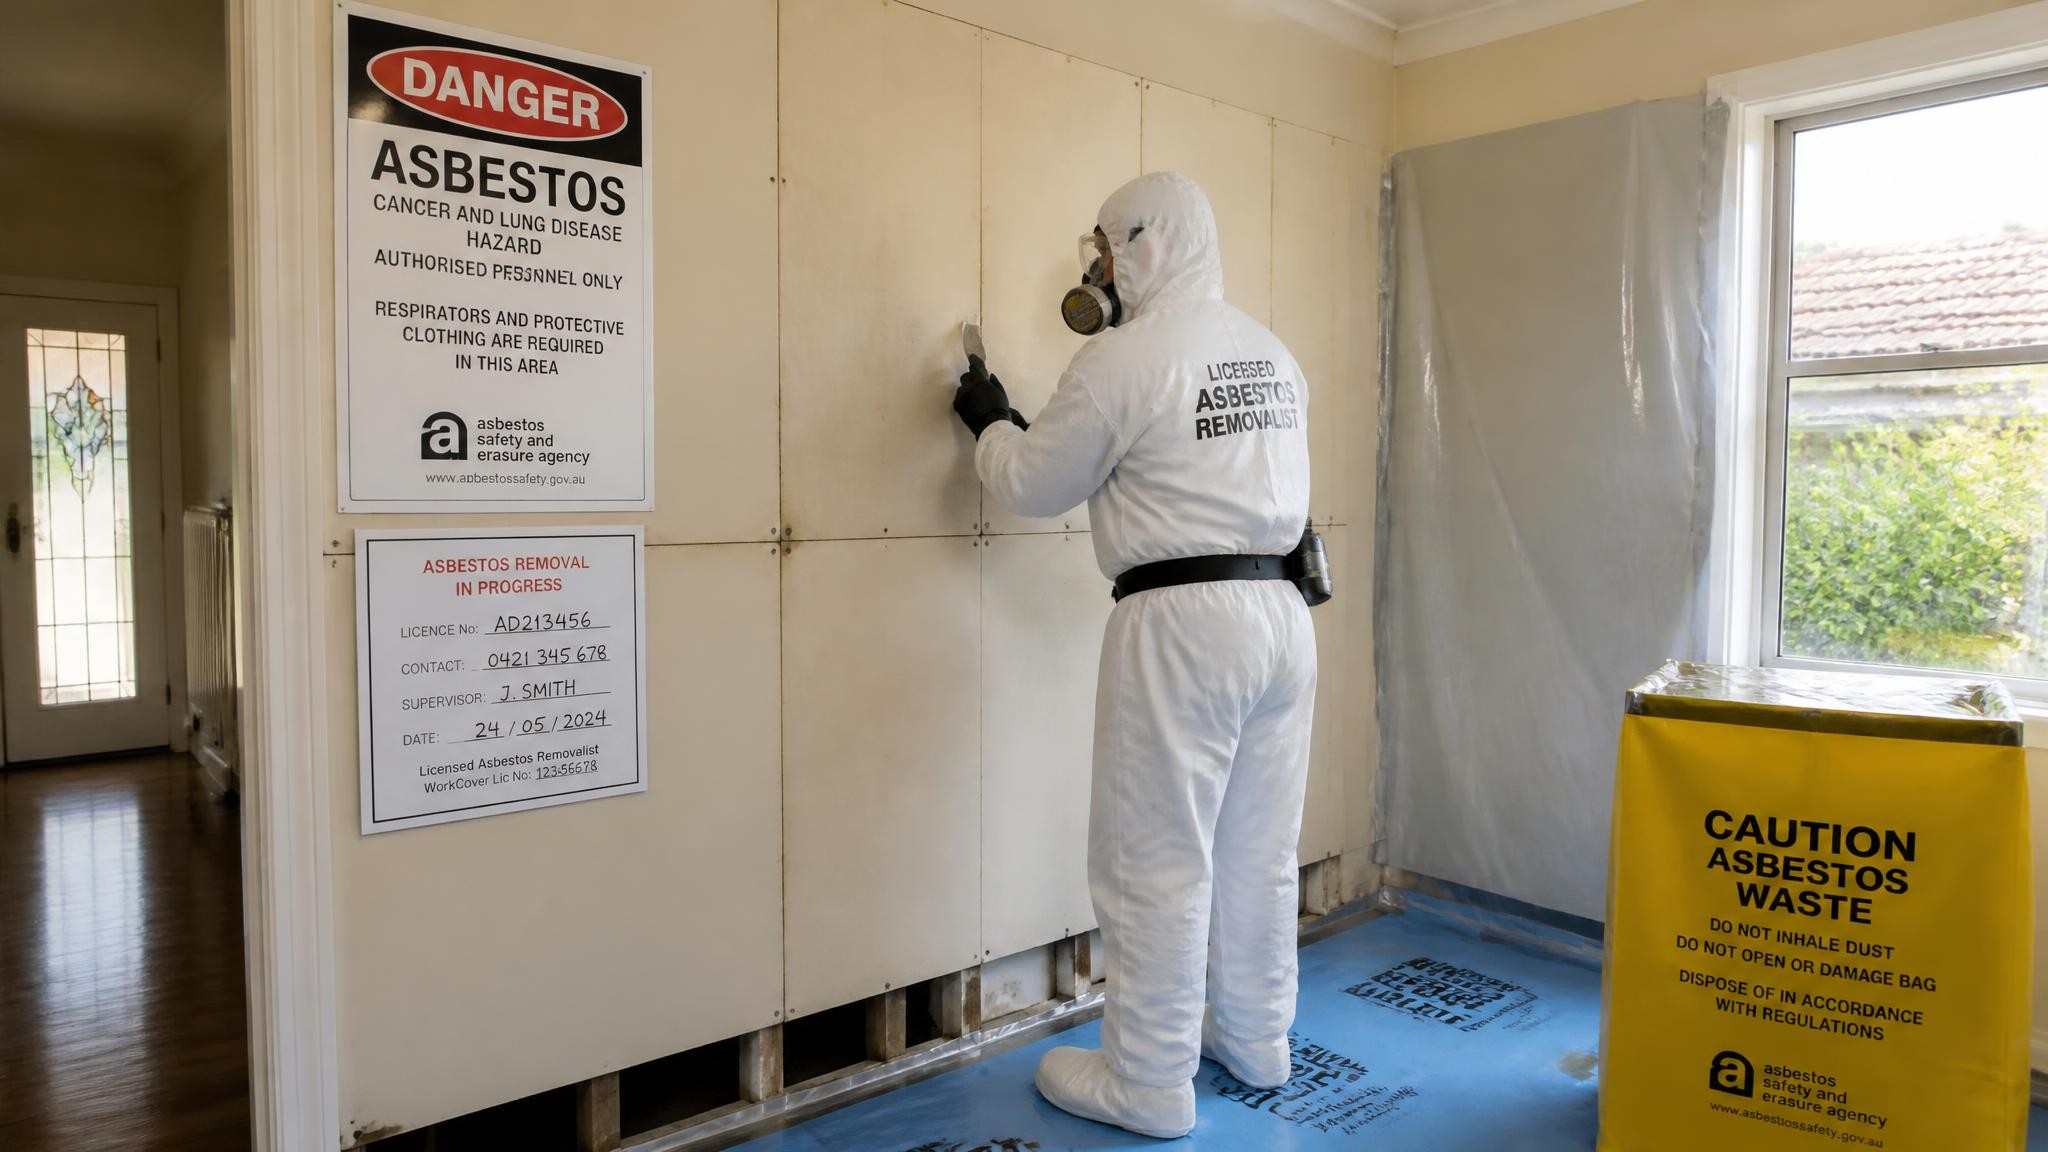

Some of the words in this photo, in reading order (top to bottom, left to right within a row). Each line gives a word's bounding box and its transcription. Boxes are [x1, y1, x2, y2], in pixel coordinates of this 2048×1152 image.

[403, 57, 600, 130] DANGER
[371, 139, 626, 216] ASBESTOS
[373, 194, 450, 219] CANCER
[456, 206, 494, 224] AND
[500, 212, 545, 232] LUNG
[551, 219, 622, 242] DISEASE
[467, 230, 542, 255] HAZARD
[374, 249, 487, 277] AUTHORISED
[583, 273, 623, 290] ONLY
[375, 301, 491, 324] RESPIRATORS
[496, 311, 529, 327] AND
[534, 315, 624, 335] PROTECTIVE
[403, 327, 486, 346] CLOTHING
[491, 333, 522, 349] ARE
[528, 336, 604, 355] REQUIRED
[455, 354, 471, 369] IN
[477, 356, 513, 371] THIS
[518, 358, 559, 375] AREA
[1195, 381, 1295, 413] ASBESTOS
[477, 417, 544, 431] asbestos
[1195, 408, 1298, 440] REMOVALIST
[477, 434, 523, 449] safety
[527, 435, 553, 447] and
[477, 451, 534, 461] erasure
[539, 451, 590, 466] agency
[423, 557, 510, 573] ASBESTOS
[515, 556, 589, 571] REMOVAL
[456, 582, 472, 596] IN
[478, 578, 562, 595] PROGRESS
[400, 625, 455, 638] LICENCE
[459, 625, 479, 635] No:
[494, 611, 591, 633] AD213456
[401, 660, 465, 675] CONTACT:
[488, 652, 528, 668] 0421
[537, 647, 570, 665] 345
[577, 645, 607, 661] 678
[402, 693, 486, 710] SUPERVISOR:
[500, 685, 516, 702] J.
[522, 679, 576, 699] SMITH
[403, 733, 440, 746] DATE:
[419, 760, 474, 777] Licensed
[478, 755, 533, 769] Asbestos
[537, 744, 599, 761] Removalist
[424, 776, 489, 793] WorkCover
[493, 774, 509, 784] Lic
[512, 771, 531, 781] No:
[1704, 809, 1916, 862] CAUTION
[1706, 847, 1909, 894] ASBESTOS
[1736, 882, 1872, 924] WASTE
[1710, 918, 1732, 933] DO
[1738, 923, 1771, 941] NOT
[1776, 930, 1840, 952] INHALE
[1845, 940, 1894, 959] DUST
[1676, 935, 1698, 951] DO
[1703, 941, 1737, 959] NOT
[1741, 948, 1786, 968] OPEN
[1790, 958, 1815, 974] OR
[1820, 963, 1893, 986] DAMAGE
[1899, 974, 1936, 992] BAG
[1679, 969, 1748, 996] DISPOSE
[1753, 984, 1775, 1000] OF
[1780, 989, 1796, 1004] IN
[1801, 993, 1924, 1025] ACCORDANCE
[1716, 997, 1757, 1018] WITH
[1762, 1007, 1884, 1041] REGULATIONS
[1763, 1077, 1812, 1099] safety
[1817, 1089, 1848, 1105] and
[1764, 1064, 1837, 1087] asbestos
[1762, 1091, 1822, 1113] erasure
[1827, 1104, 1888, 1130] agency
